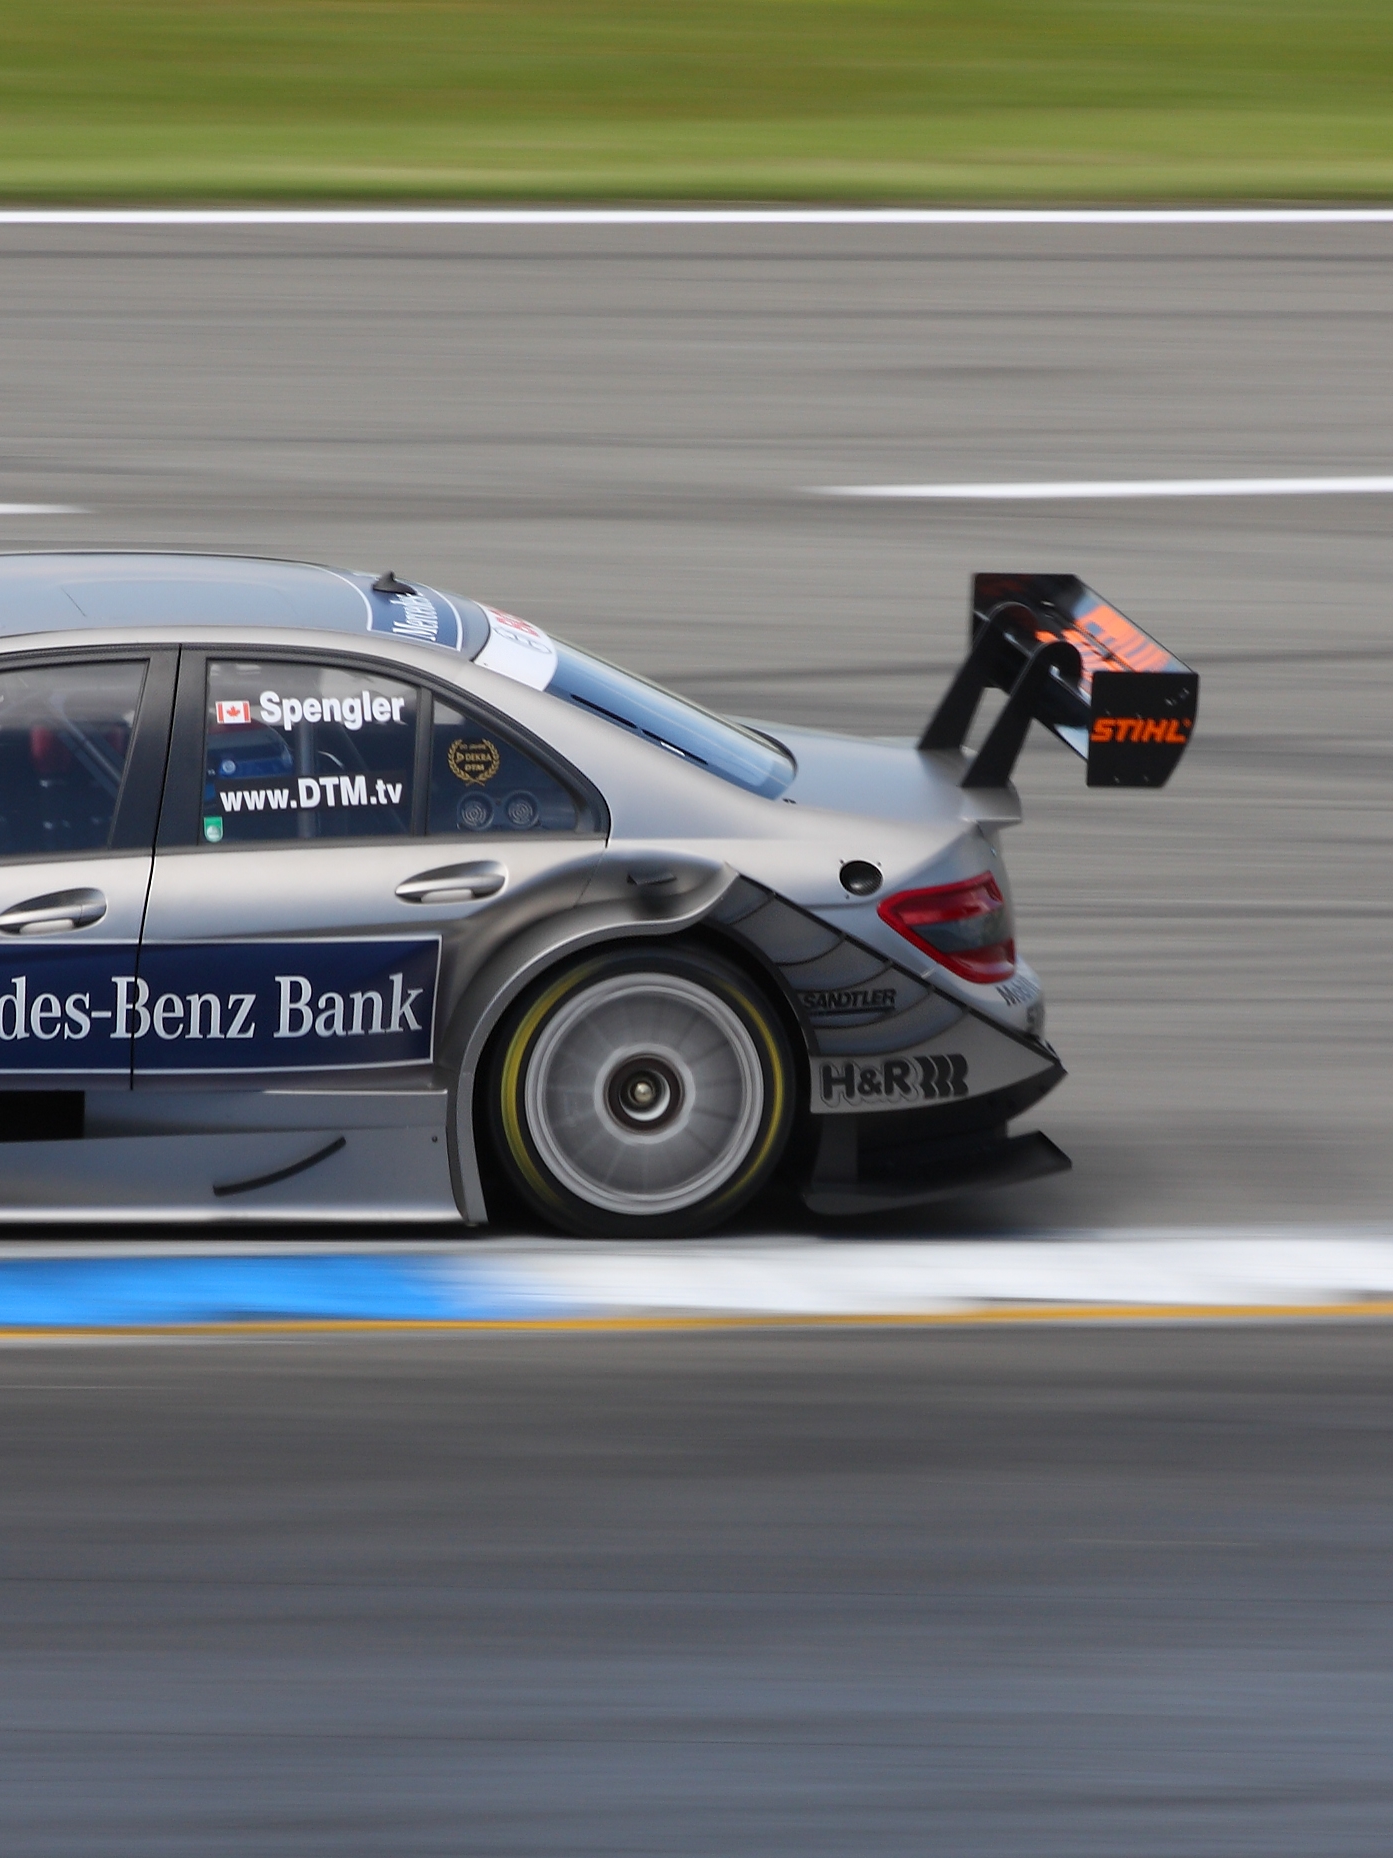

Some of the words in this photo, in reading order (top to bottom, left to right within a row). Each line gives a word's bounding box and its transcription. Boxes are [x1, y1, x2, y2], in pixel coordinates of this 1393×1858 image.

[259, 690, 405, 731] Spengler
[1090, 717, 1187, 744] STIHL
[219, 775, 403, 813] www.DTM.tv
[272, 972, 424, 1039] Bank
[804, 988, 897, 1008] SANDTLER
[820, 1058, 912, 1102] H&R
